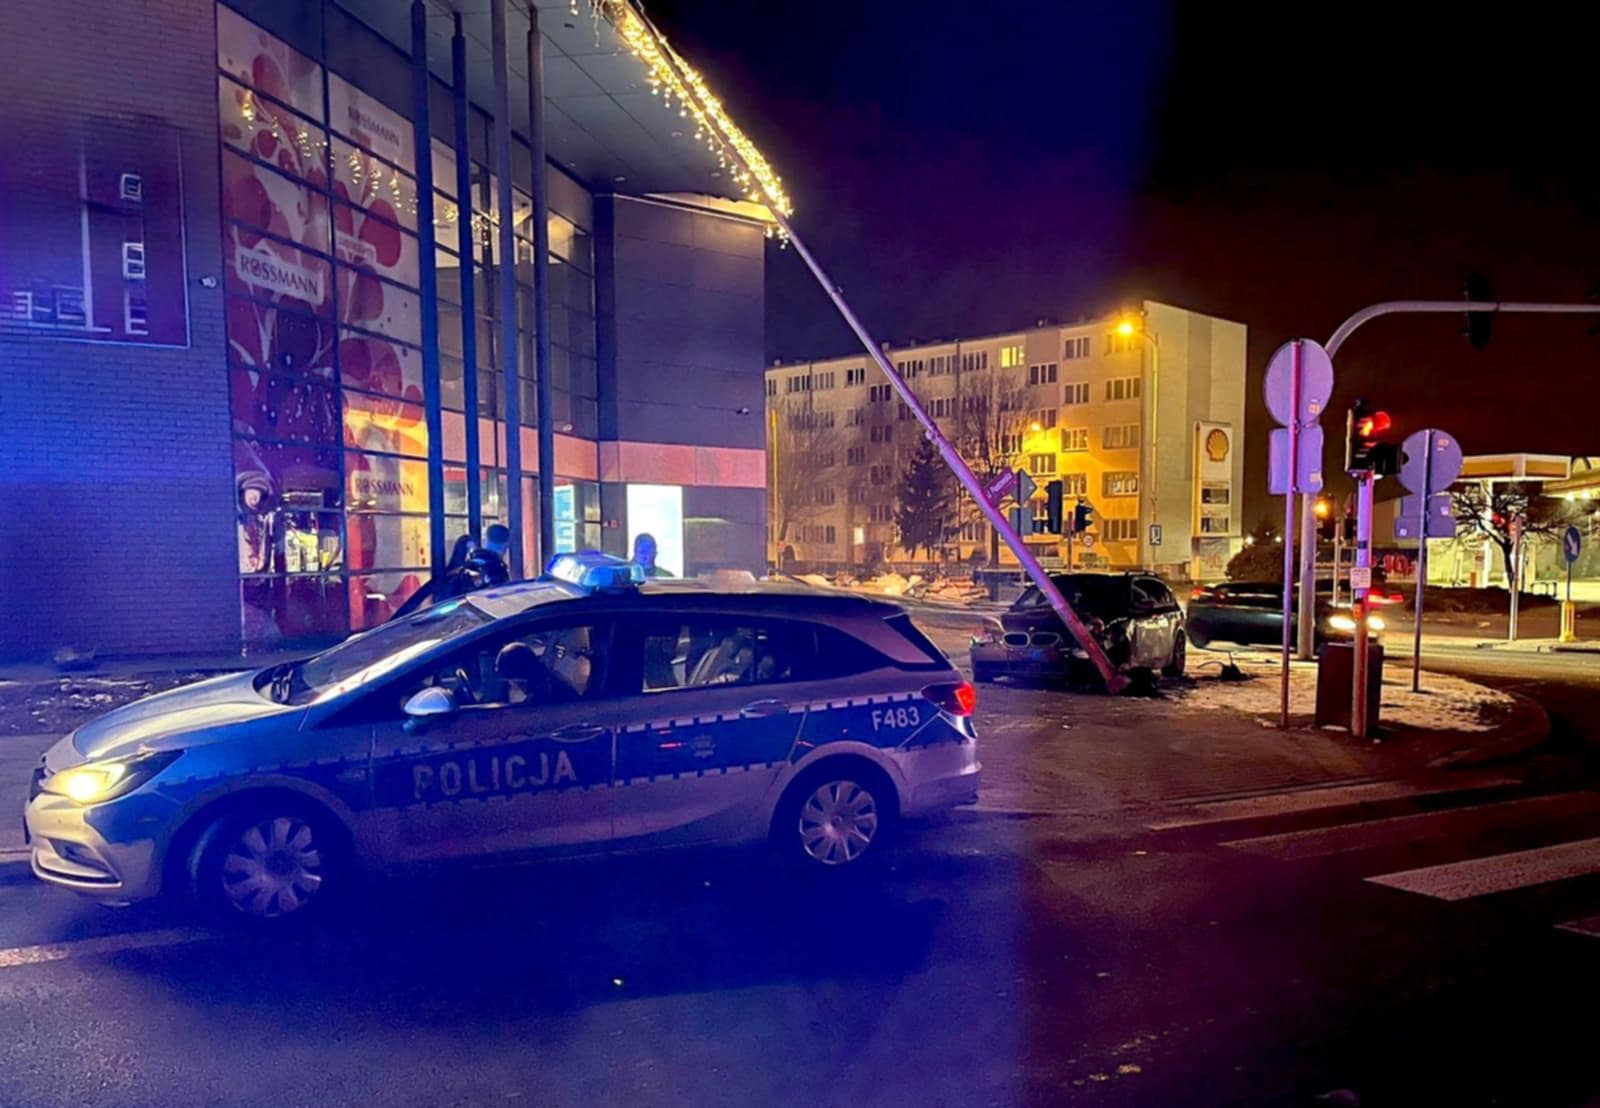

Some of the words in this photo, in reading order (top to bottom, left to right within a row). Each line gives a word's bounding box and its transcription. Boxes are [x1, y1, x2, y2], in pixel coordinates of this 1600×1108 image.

[240, 254, 318, 296] ROSSMANN
[355, 478, 414, 496] ROSSMANN
[871, 706, 920, 731] F483
[413, 750, 577, 799] POLICJA
